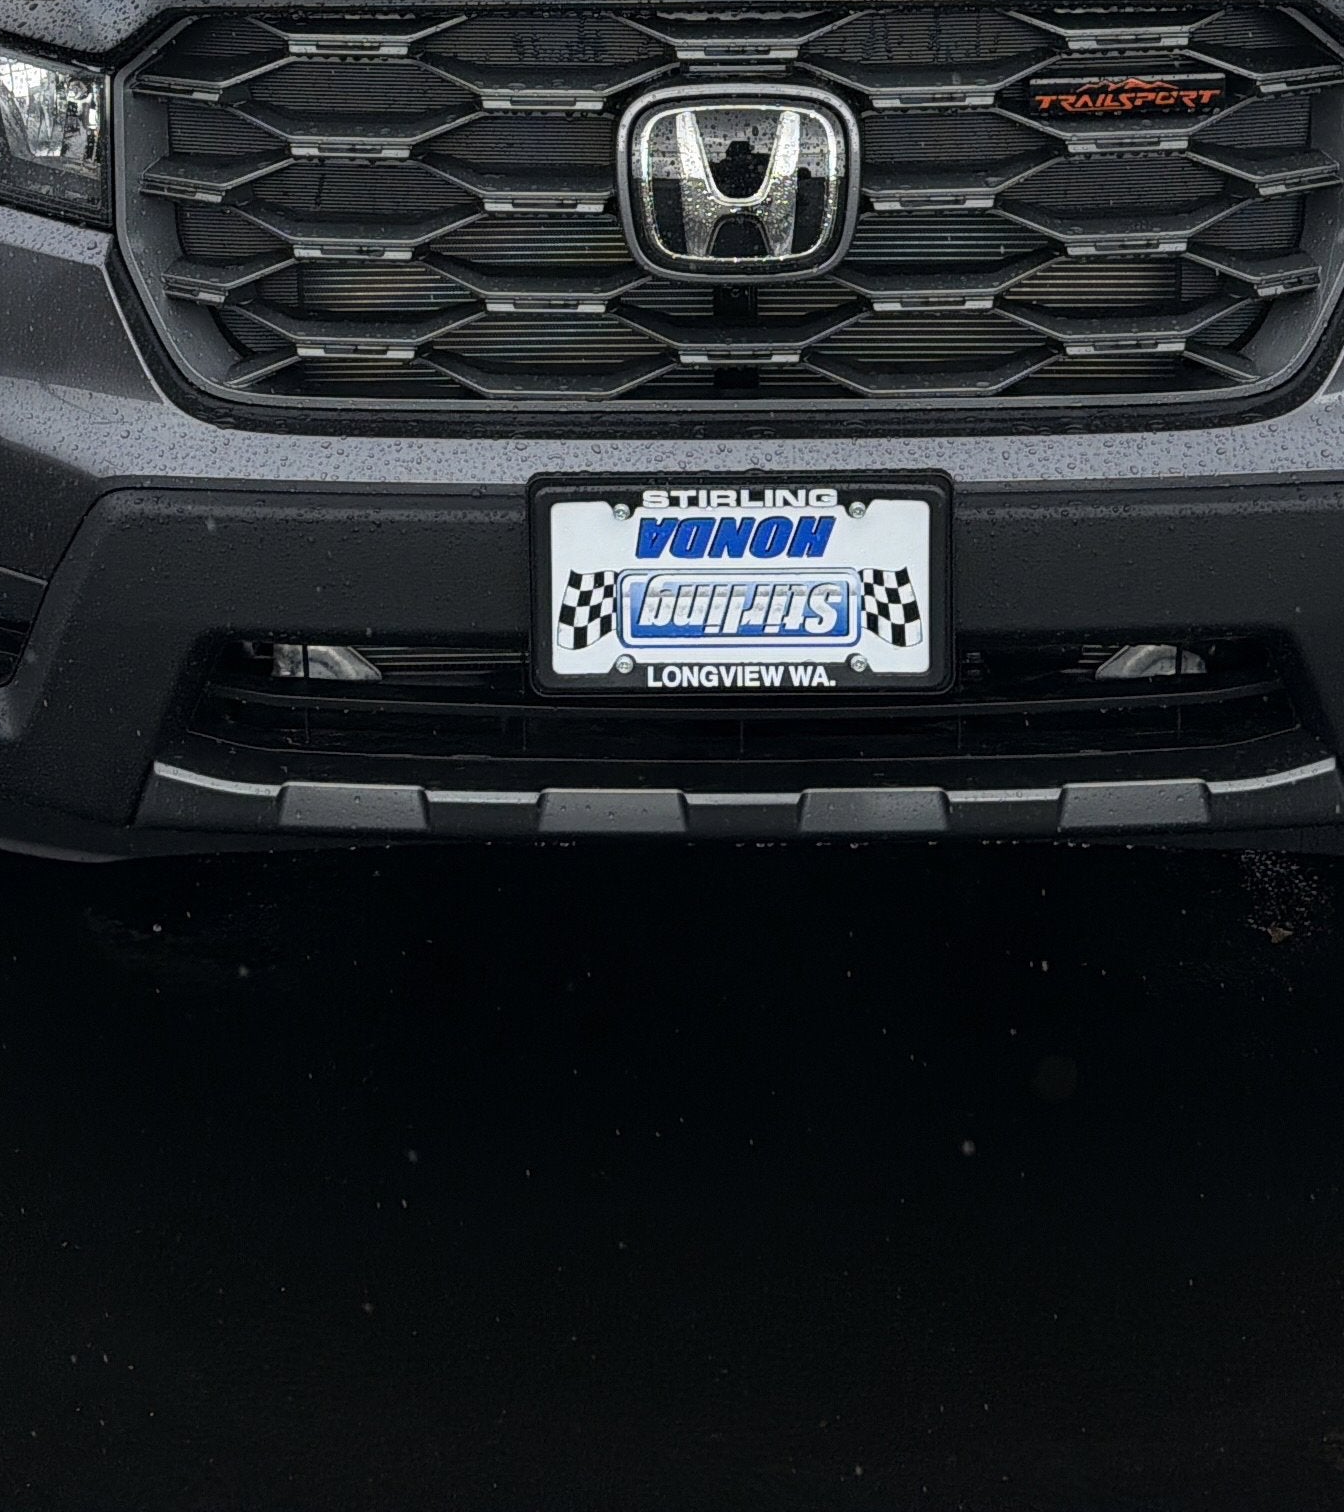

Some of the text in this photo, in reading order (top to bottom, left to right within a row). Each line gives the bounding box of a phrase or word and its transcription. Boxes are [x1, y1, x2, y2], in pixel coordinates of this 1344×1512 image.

[1034, 89, 1222, 112] TRAILSPORT
[641, 488, 839, 509] STIRLING
[635, 515, 838, 559] HONDA
[637, 573, 843, 634] Stirling
[646, 665, 837, 688] LONGVIEW WA.
